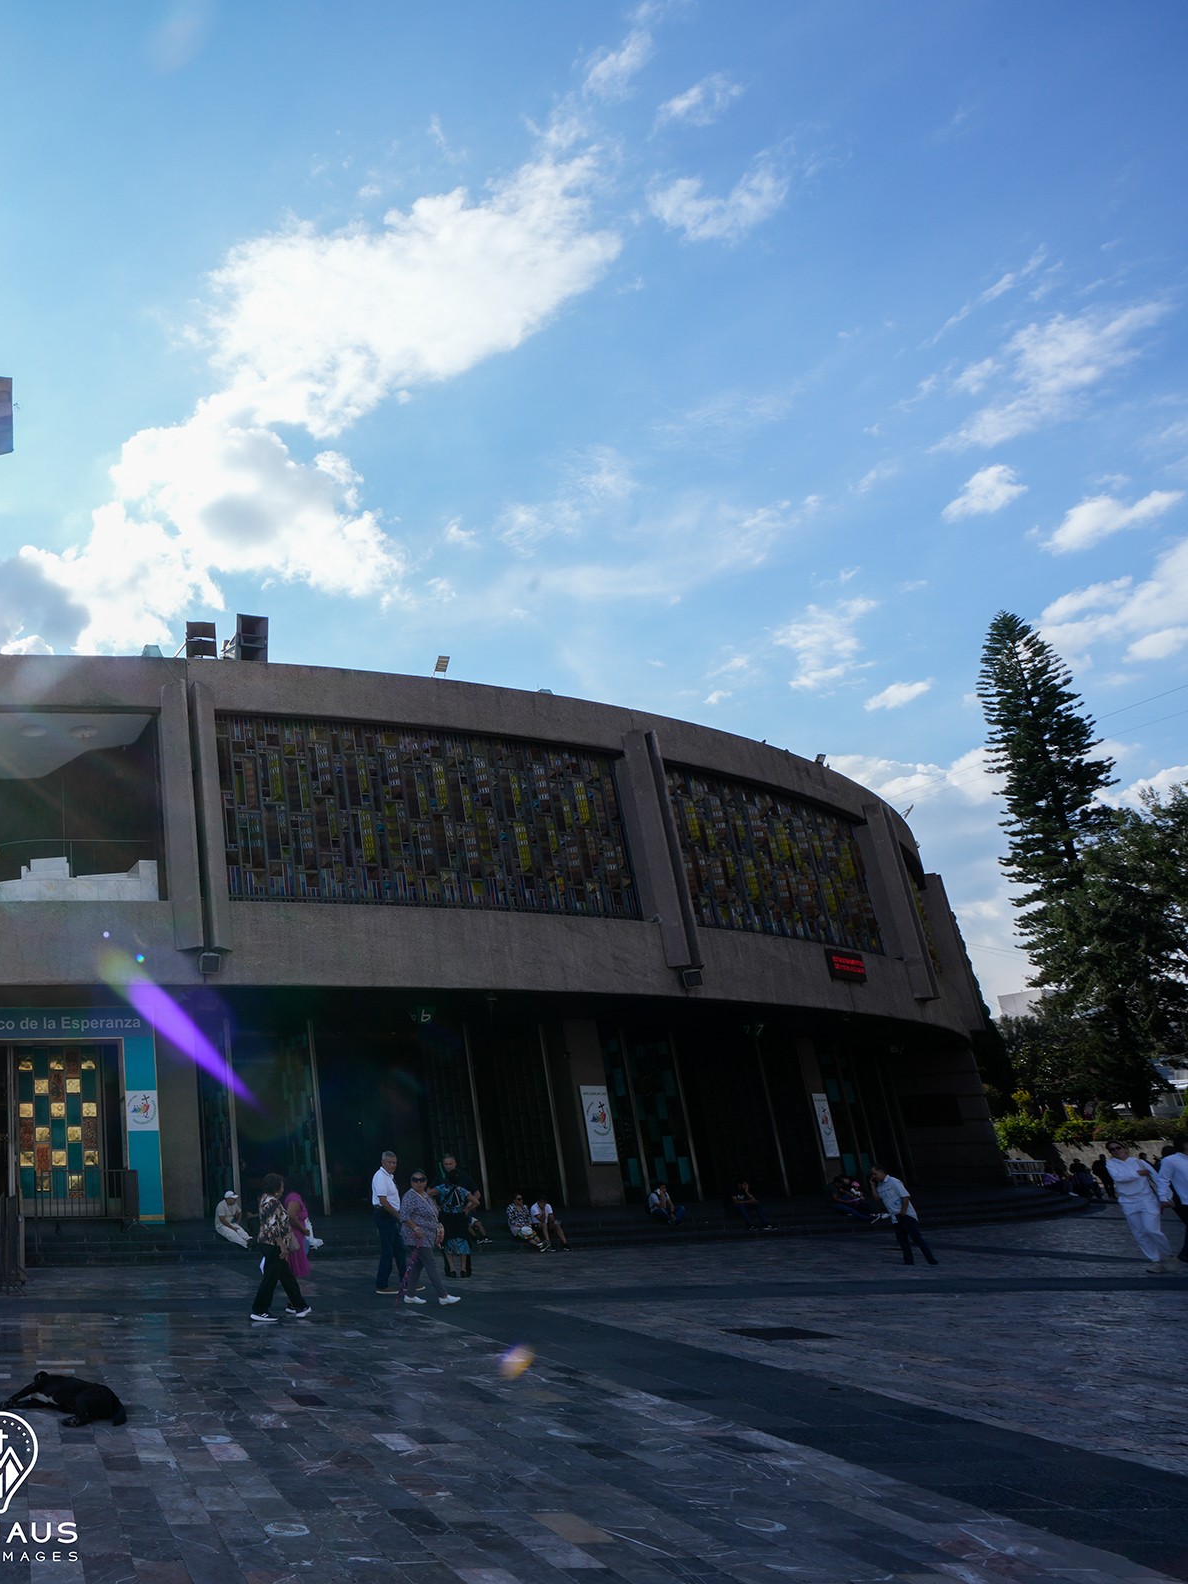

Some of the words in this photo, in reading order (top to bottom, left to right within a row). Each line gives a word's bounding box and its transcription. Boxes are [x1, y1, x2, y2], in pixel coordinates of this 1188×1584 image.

[20, 1017, 38, 1030] de
[43, 1017, 56, 1030] la
[61, 1016, 141, 1032] Esperanza
